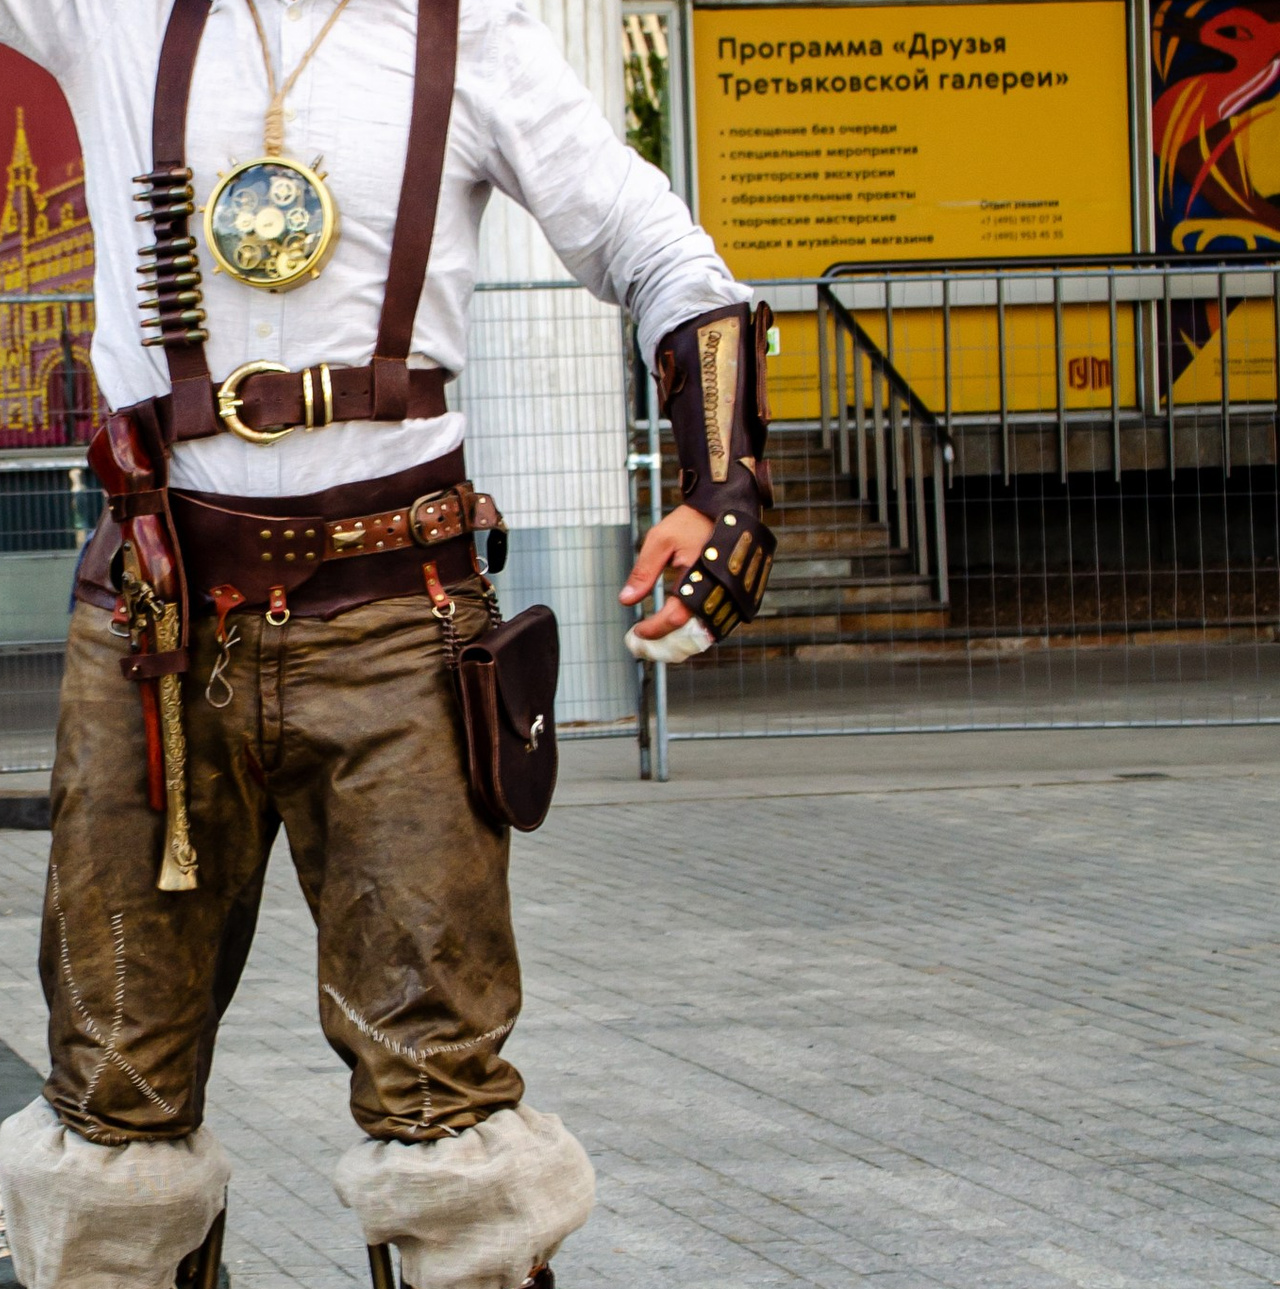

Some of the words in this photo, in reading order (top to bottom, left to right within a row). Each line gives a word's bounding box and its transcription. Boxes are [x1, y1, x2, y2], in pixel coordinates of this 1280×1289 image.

[718, 37, 883, 64] Программа
[893, 33, 1007, 60] «Друзья
[718, 68, 928, 101] Третьяковской
[939, 68, 1070, 94] галереи»
[729, 126, 807, 138] посещение
[812, 123, 835, 135] без
[839, 123, 898, 136] очереди
[729, 148, 822, 160] специальные
[826, 145, 919, 158] мероприятия
[731, 170, 820, 184] кураторские
[824, 168, 896, 181] экскурсии
[731, 192, 853, 205] образовательные
[857, 190, 917, 203] проекты
[732, 215, 810, 228] творческие
[815, 213, 897, 226] мастерские
[733, 238, 782, 250] скидки
[797, 235, 866, 250] музейном
[871, 233, 934, 246] магазине
